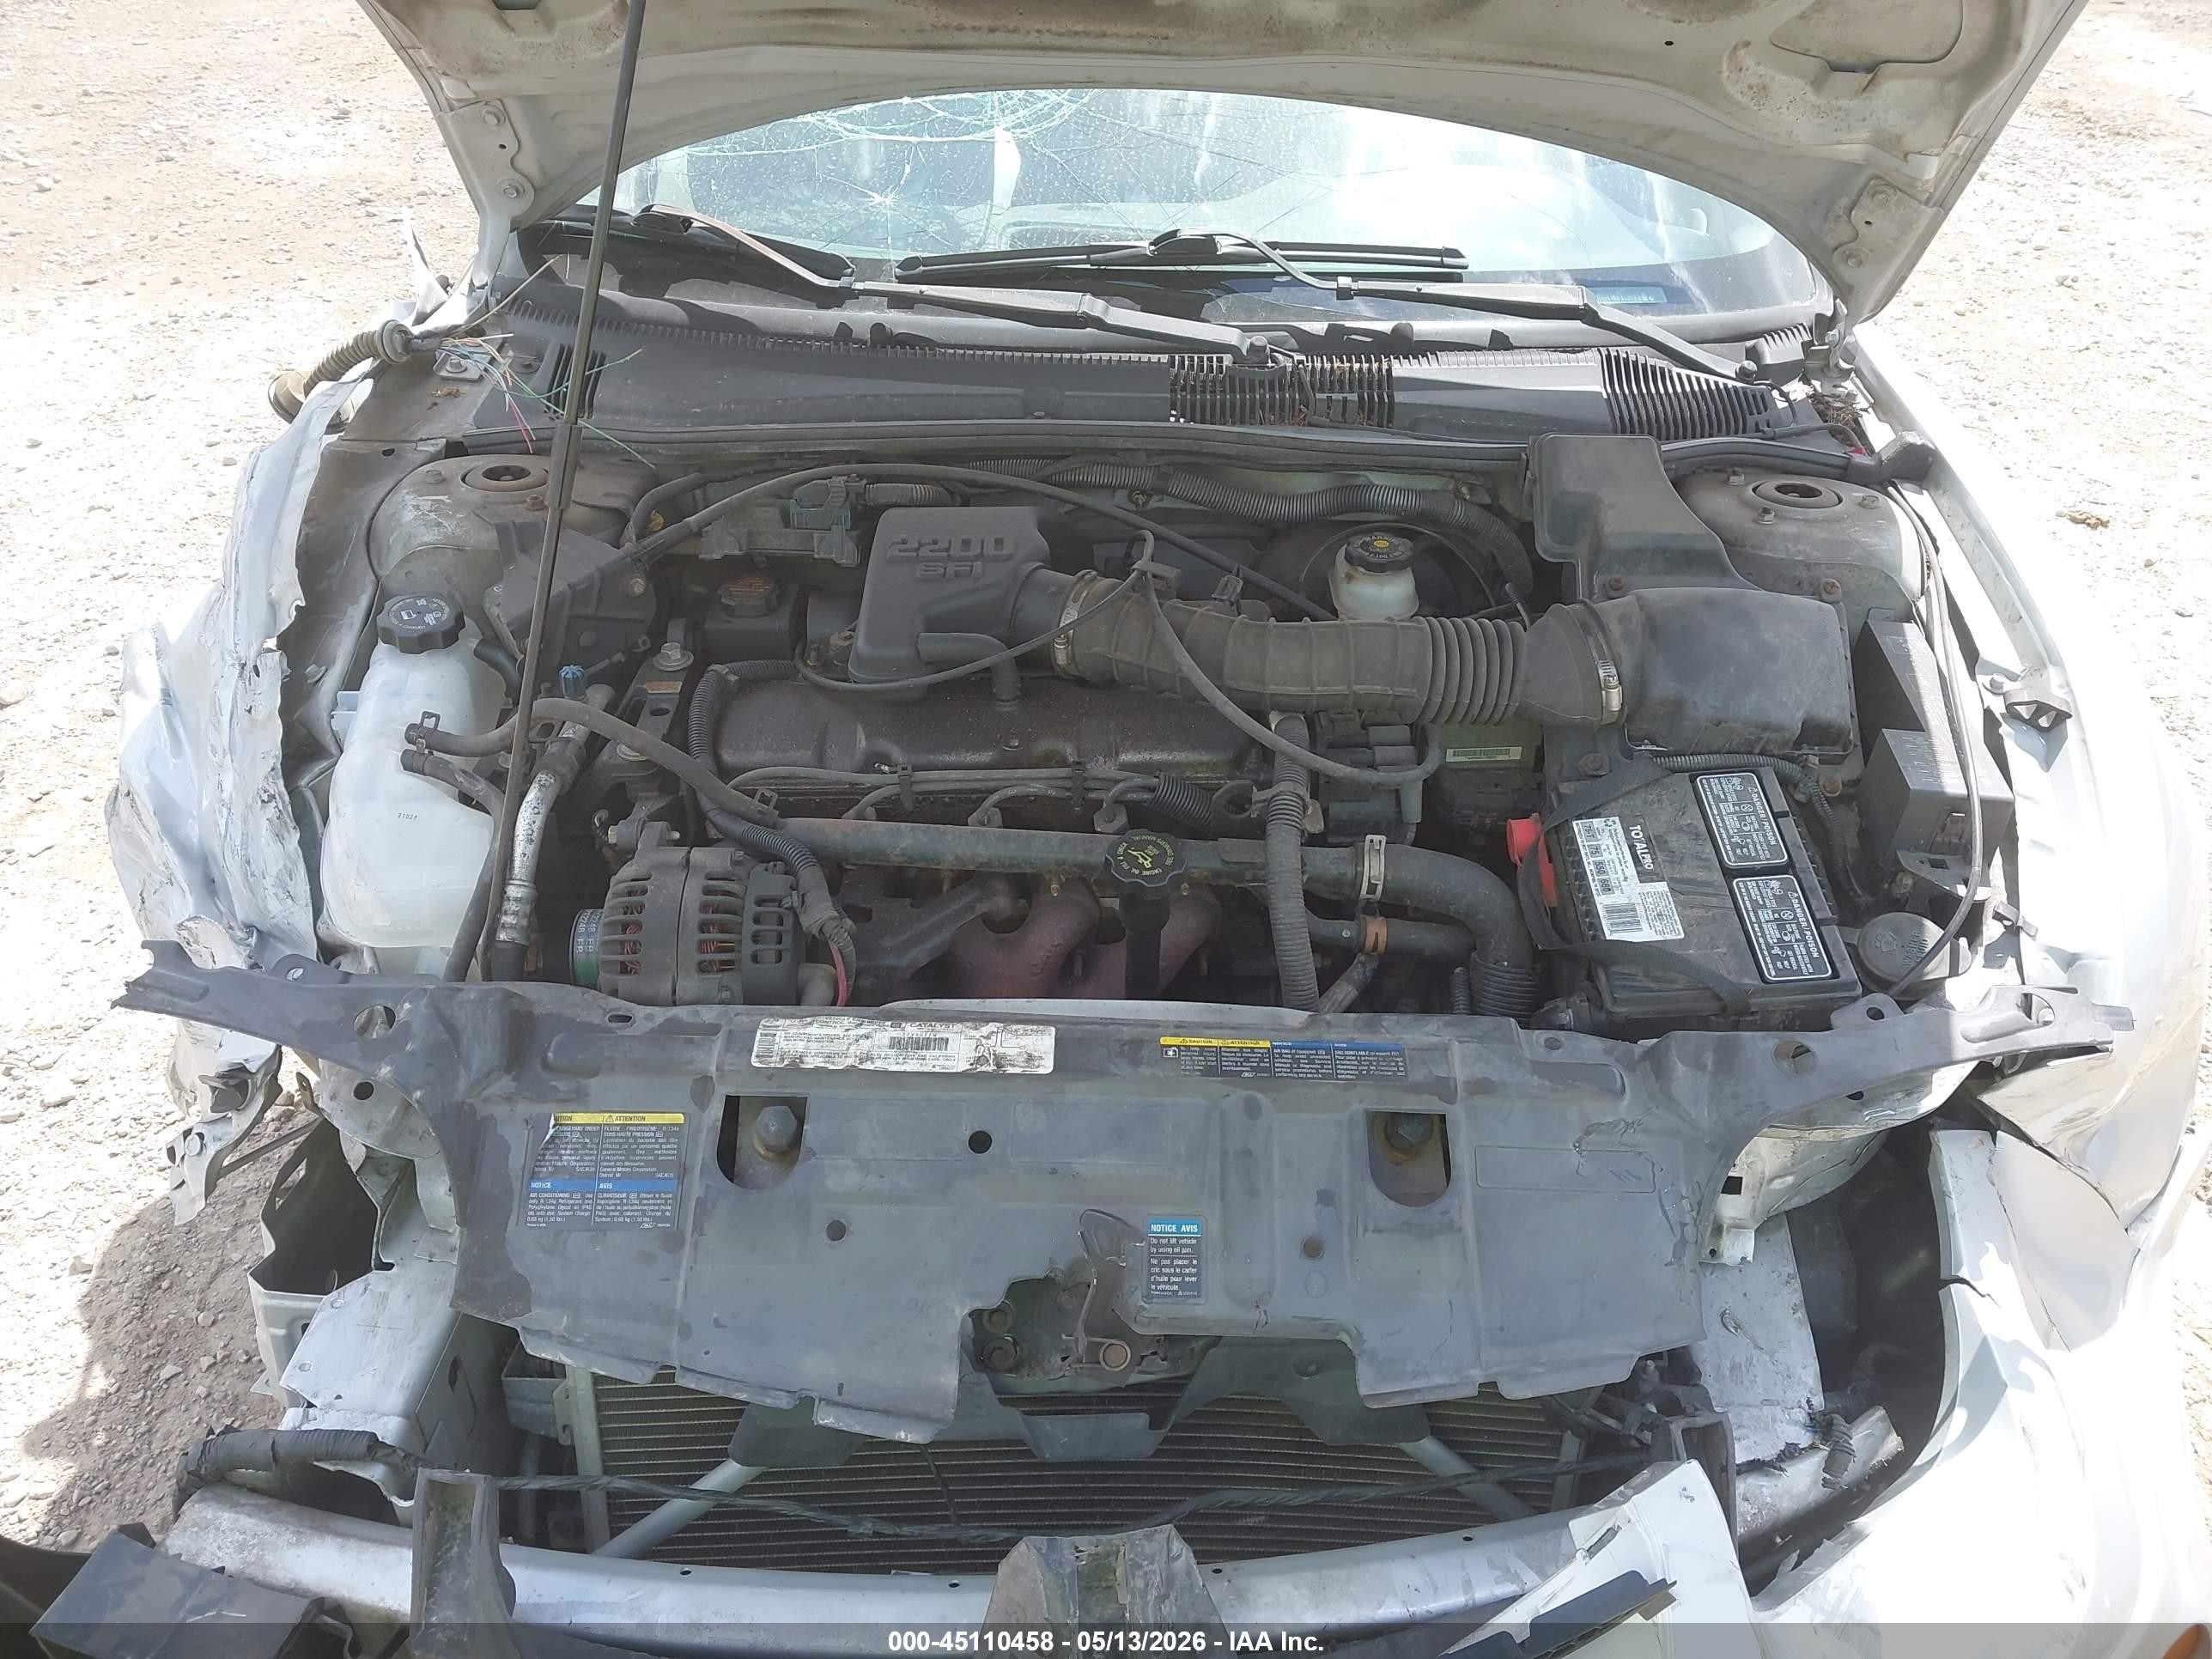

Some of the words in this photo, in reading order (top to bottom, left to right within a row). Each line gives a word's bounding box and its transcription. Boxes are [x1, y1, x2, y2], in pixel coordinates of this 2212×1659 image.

[887, 535, 1016, 562] 2200
[916, 562, 983, 580] SFI
[1589, 846, 1600, 855] 75
[1594, 861, 1607, 875] 550
[1599, 878, 1612, 892] 680
